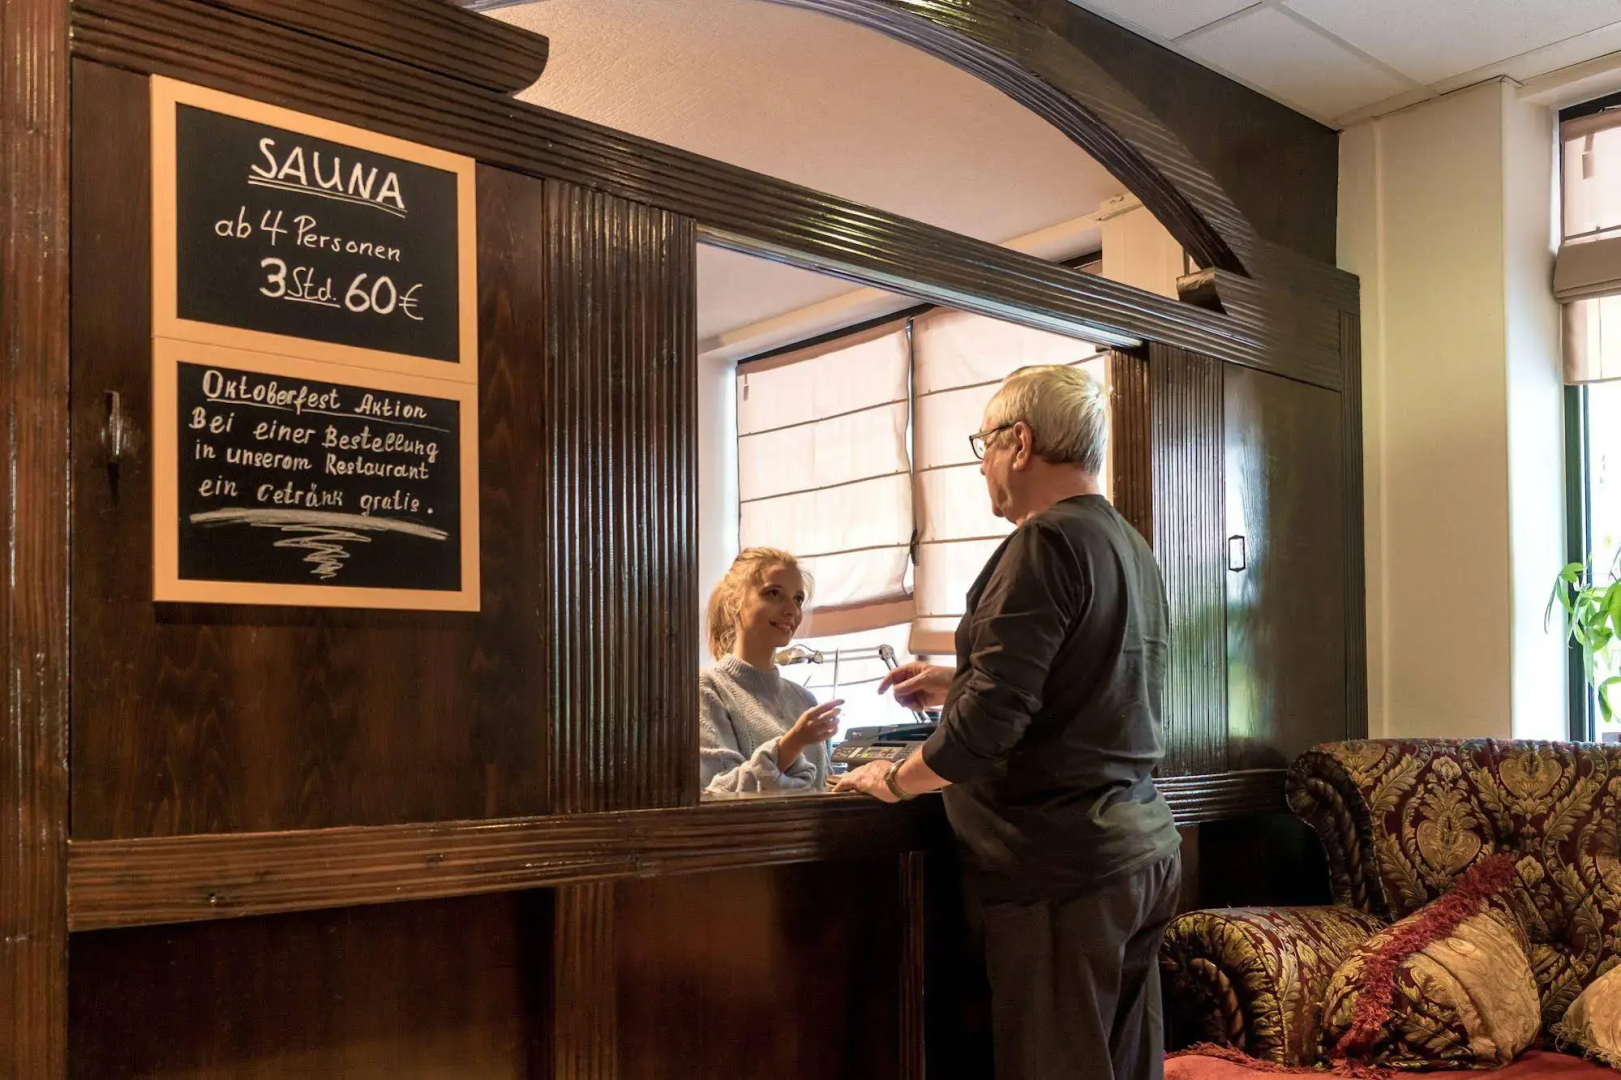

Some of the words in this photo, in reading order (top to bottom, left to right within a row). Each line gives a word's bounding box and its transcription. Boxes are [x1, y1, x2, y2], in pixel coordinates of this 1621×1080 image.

[250, 138, 406, 210] SAUNA
[214, 205, 252, 238] ab
[260, 209, 288, 247] 4
[293, 214, 401, 263] Personen
[259, 257, 288, 298] 3
[202, 369, 341, 415] Oktoberfest
[353, 393, 428, 420] Aktion
[189, 406, 235, 434] Bei
[253, 420, 316, 444] einer
[321, 424, 439, 464] Bestellung
[195, 439, 216, 460] in
[326, 452, 429, 480] Restaurant
[199, 475, 239, 497] ein
